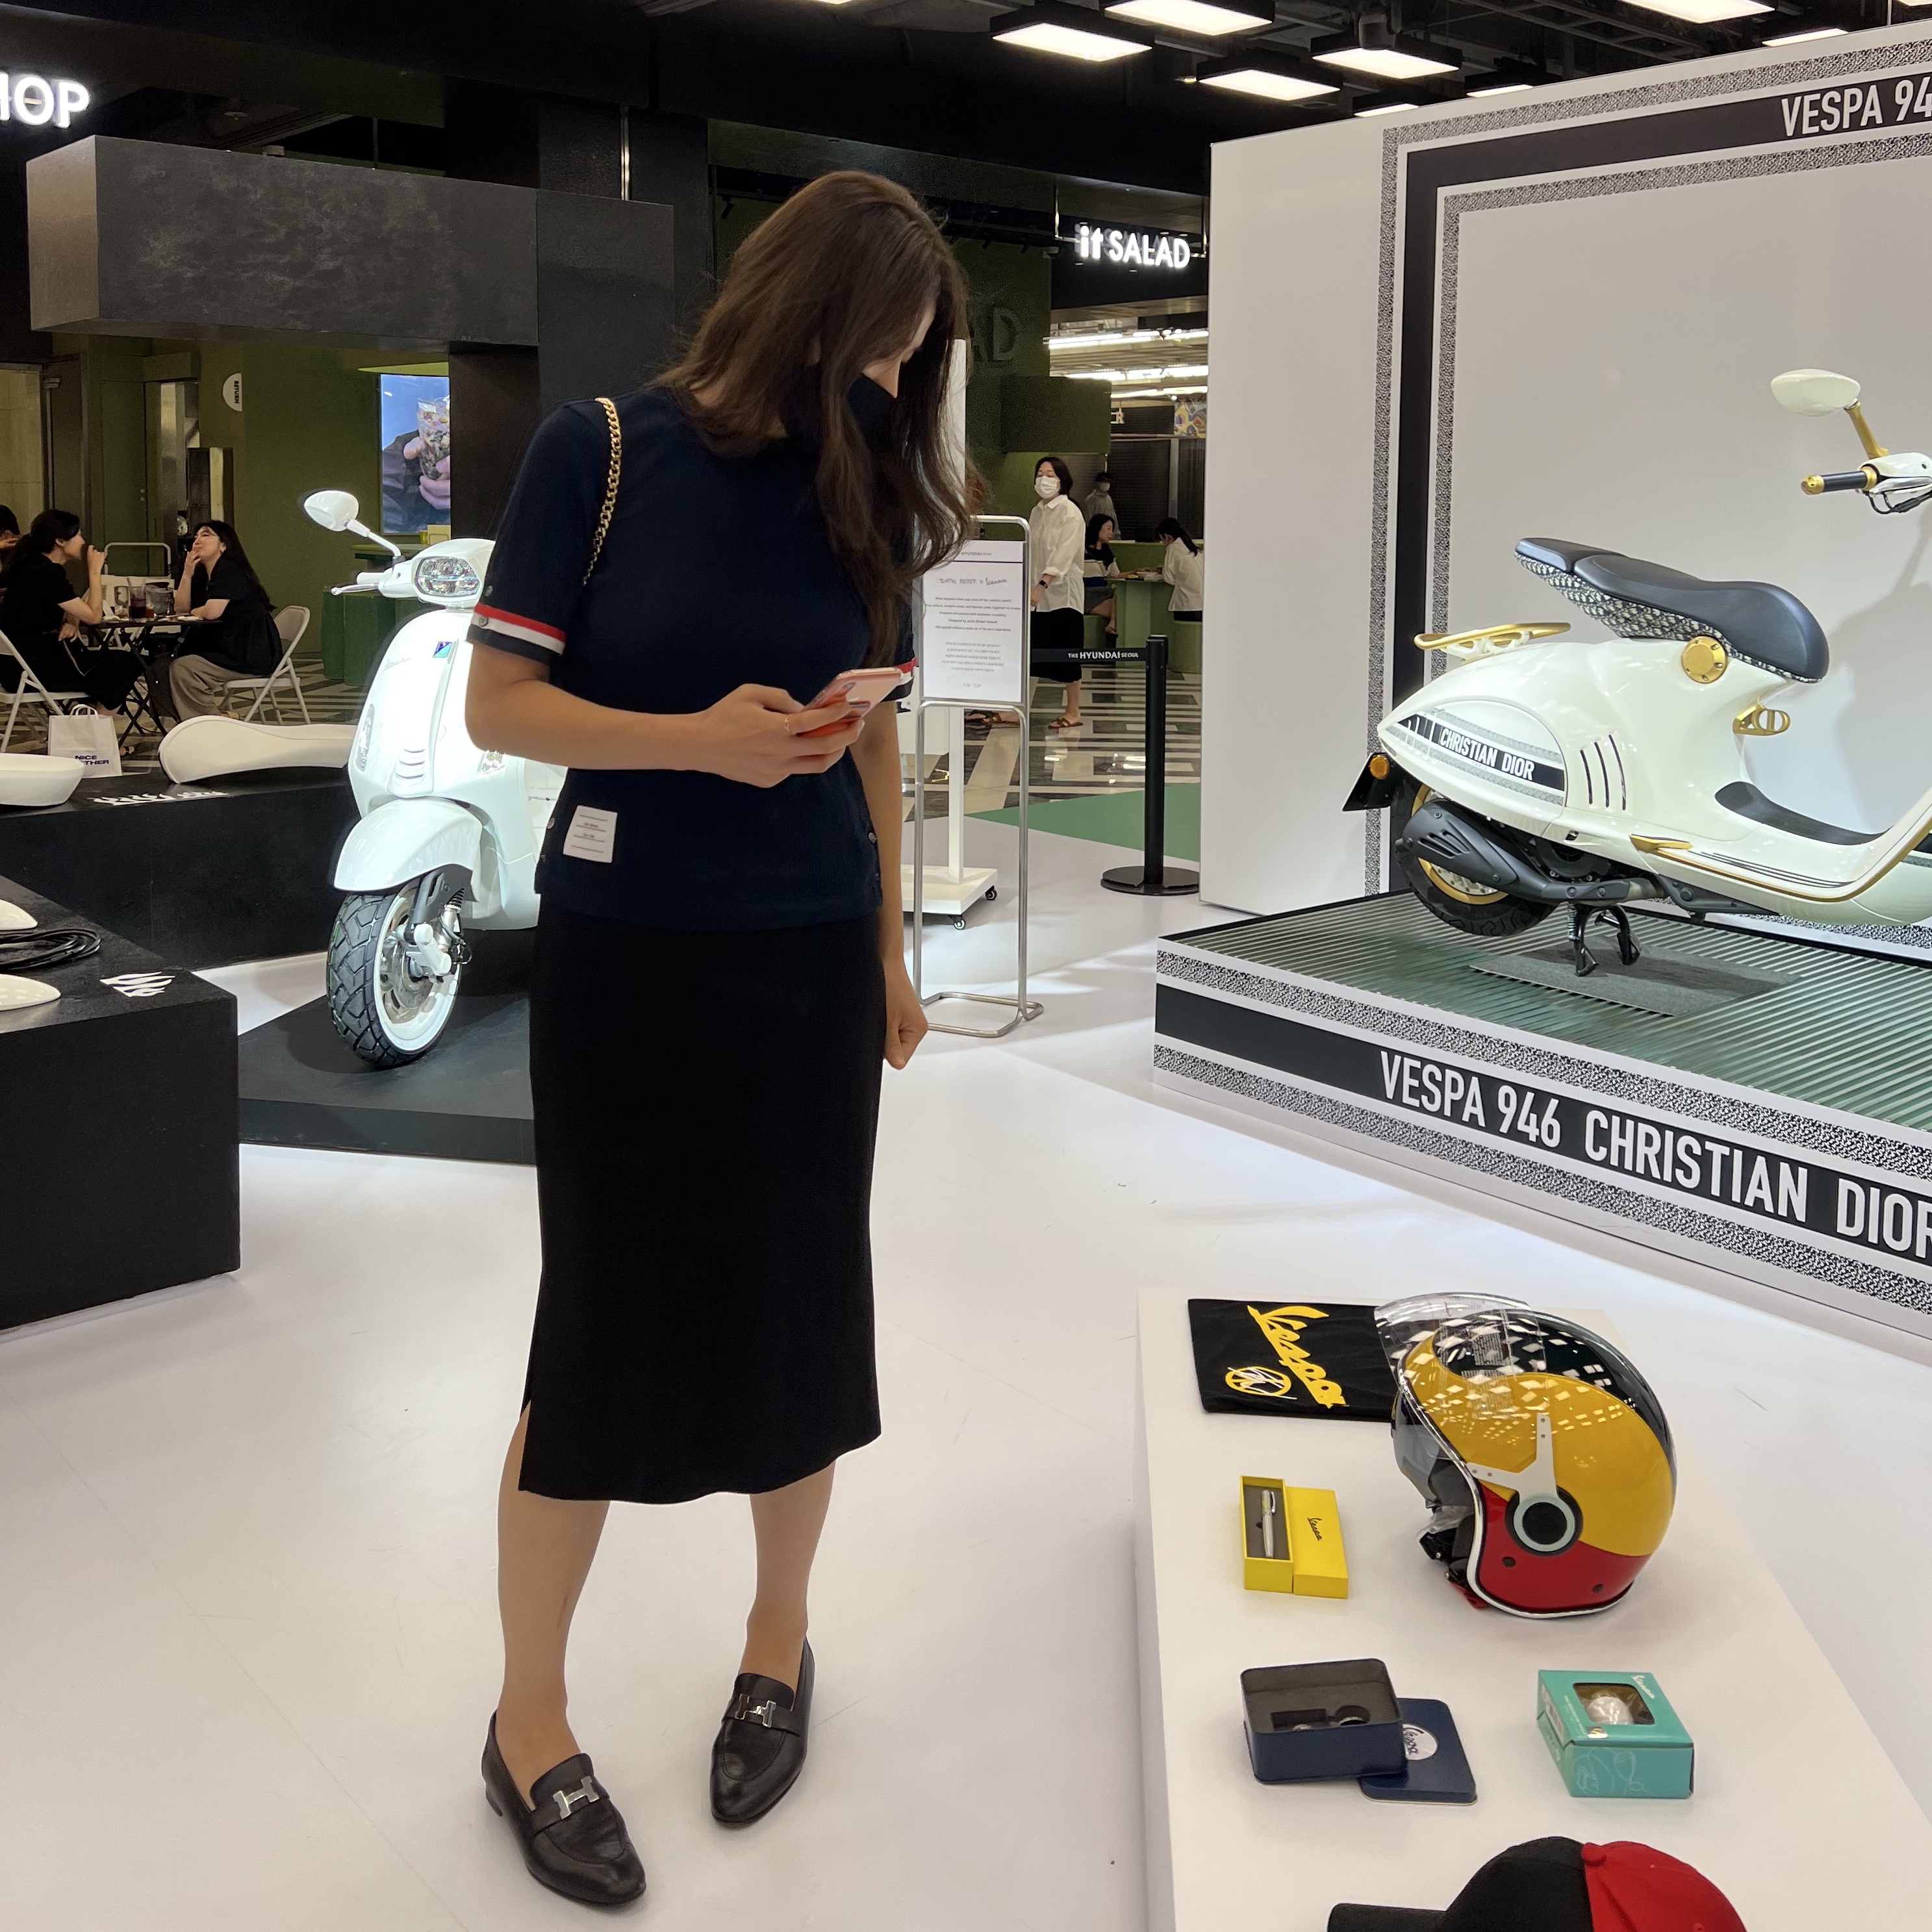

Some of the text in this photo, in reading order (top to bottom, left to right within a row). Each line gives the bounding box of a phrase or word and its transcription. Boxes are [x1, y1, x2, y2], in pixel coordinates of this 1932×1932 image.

[1781, 84, 1883, 136] VESPA
[1108, 230, 1191, 269] SALAD
[1079, 651, 1121, 659] HYUNDAI
[1440, 728, 1535, 780] CHRISTIAN DIOR
[1380, 1050, 1932, 1259] VESPA 946 CHRISTIAN DIOR
[1247, 1305, 1347, 1408] Vespa
